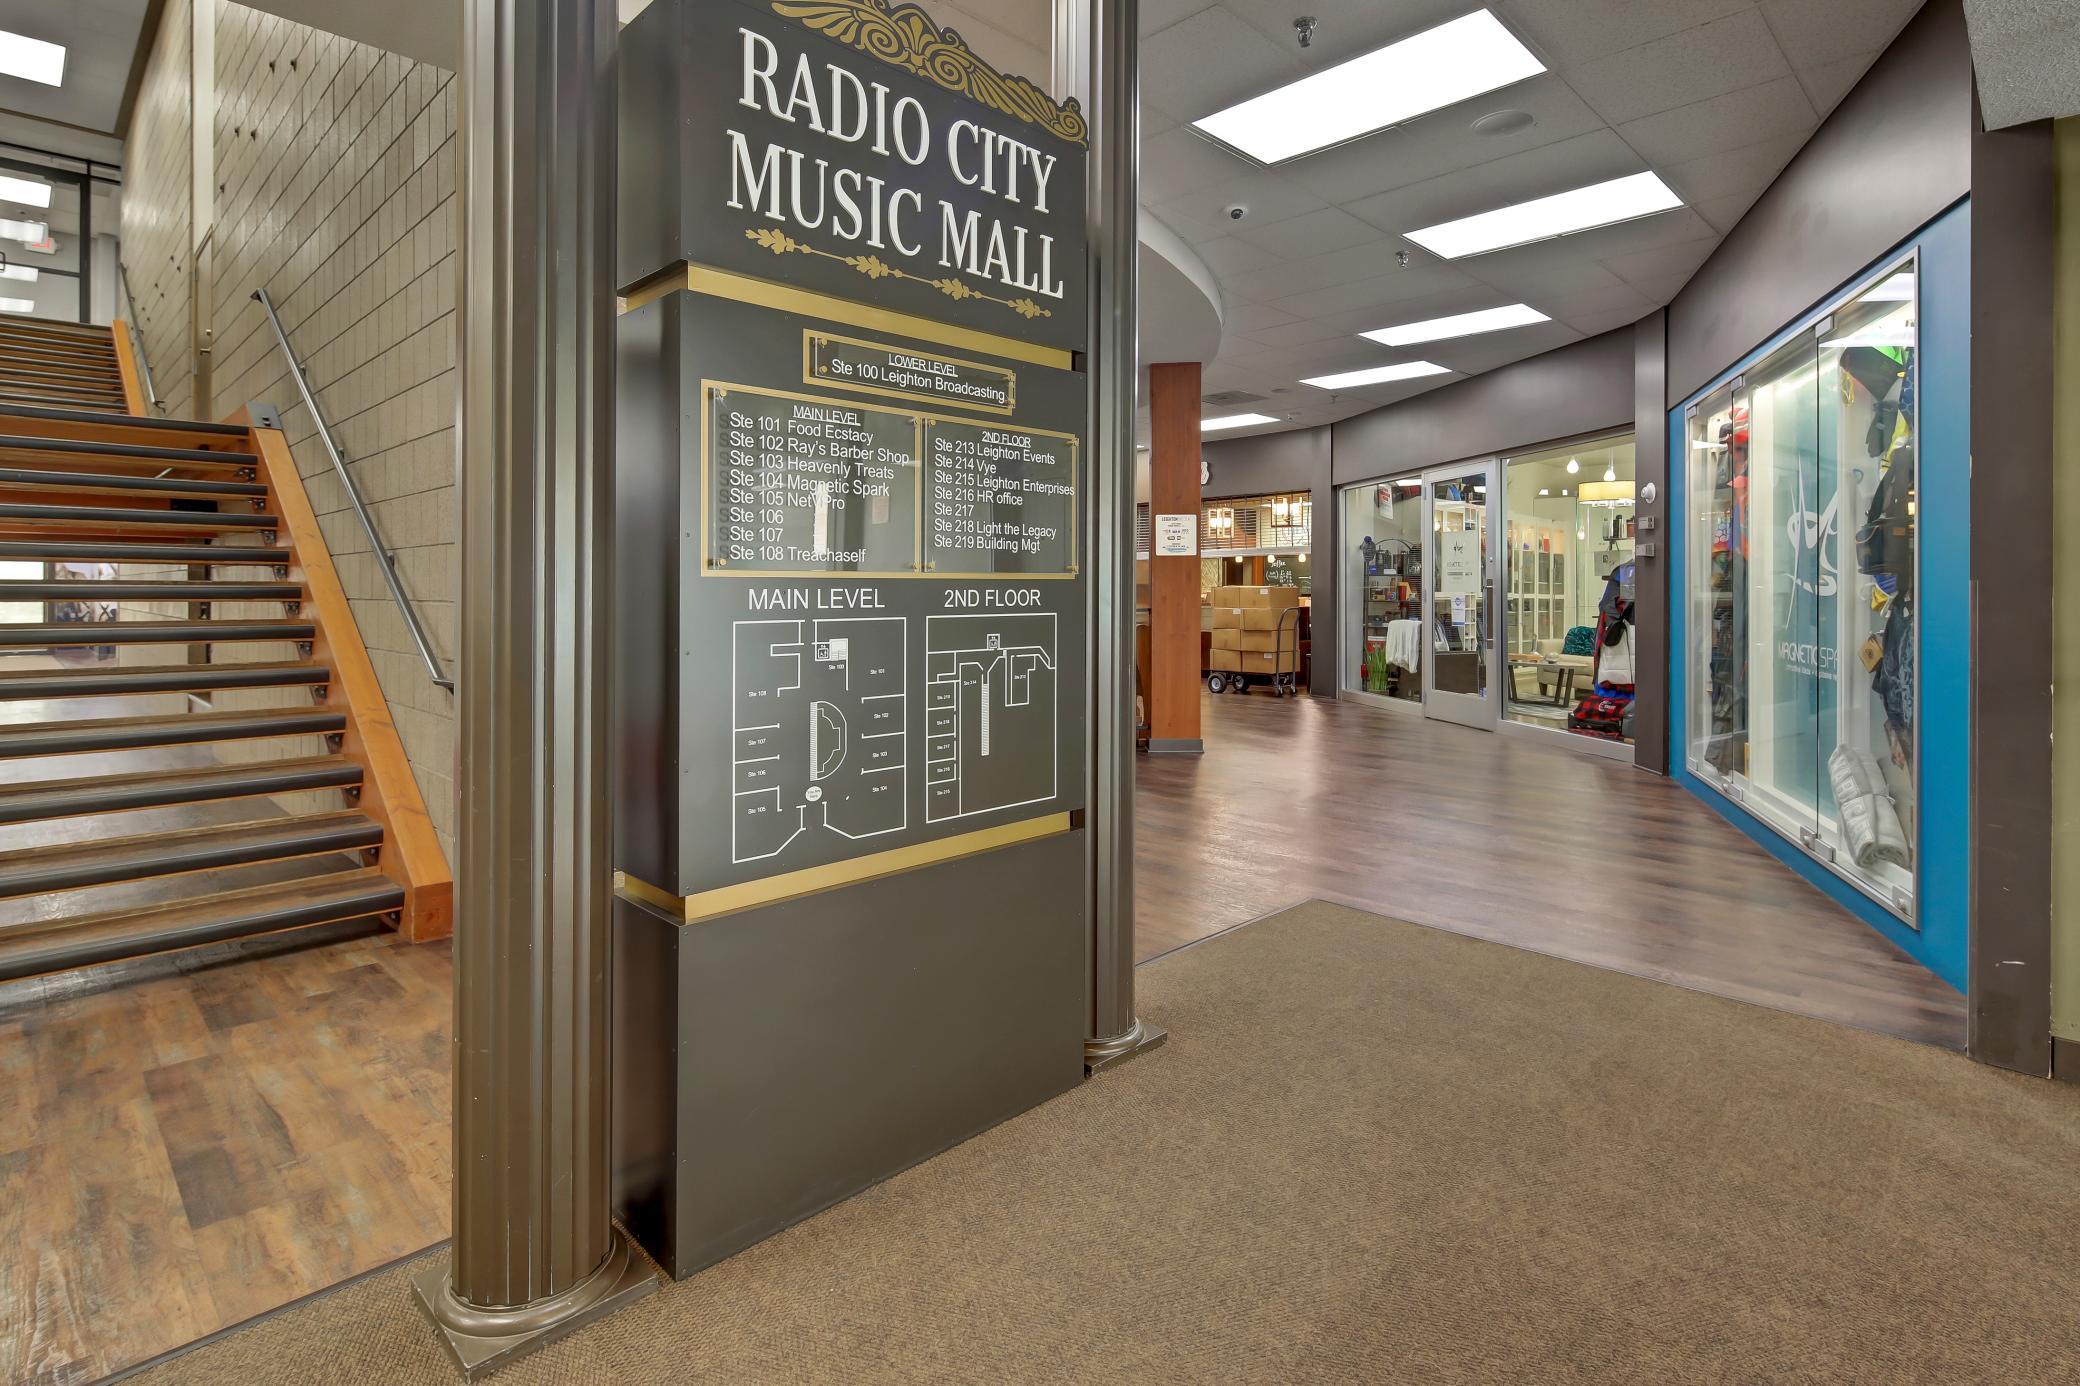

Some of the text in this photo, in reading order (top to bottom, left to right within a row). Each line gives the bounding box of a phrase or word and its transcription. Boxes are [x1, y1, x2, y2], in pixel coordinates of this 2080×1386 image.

[738, 27, 1057, 214] RADIO CITY
[726, 128, 1063, 299] MUSIC MALL
[888, 353, 958, 377] LOWER LEVEL
[831, 358, 1005, 403] Ste 100 Leighton Broadcasting
[793, 405, 861, 426] MAIN LEVEL
[730, 411, 874, 446] Ste 101 Food Ecstacy
[981, 431, 1031, 448] 2ND FLOOR
[730, 431, 754, 448] Ste
[759, 434, 784, 451] 102
[830, 442, 874, 460] Barber
[877, 447, 910, 467] Shop
[934, 437, 1056, 465] Ste 213 Leighton Events
[730, 450, 895, 479] Ste 103 Heavenly Treats
[934, 453, 997, 475] Ste 214 Vye
[730, 468, 890, 499] Ste 104 Magnetic Spark
[934, 469, 1075, 497] Ste 215 Leighton Enterprises
[730, 487, 754, 504] Ste
[759, 489, 784, 506] 105
[934, 486, 1023, 506] Ste 216 HR office
[730, 506, 784, 524] Ste 106
[934, 502, 975, 517] Ste 217
[730, 525, 784, 542] Ste 107
[934, 518, 1057, 540] Ste 218 Light the Legacy
[730, 544, 754, 560] Ste
[759, 545, 784, 561] 108
[934, 534, 1041, 554] Ste 219 Building Mgt
[748, 588, 885, 611] MAIN LEVEL
[944, 589, 1041, 608] 2ND FLOOR
